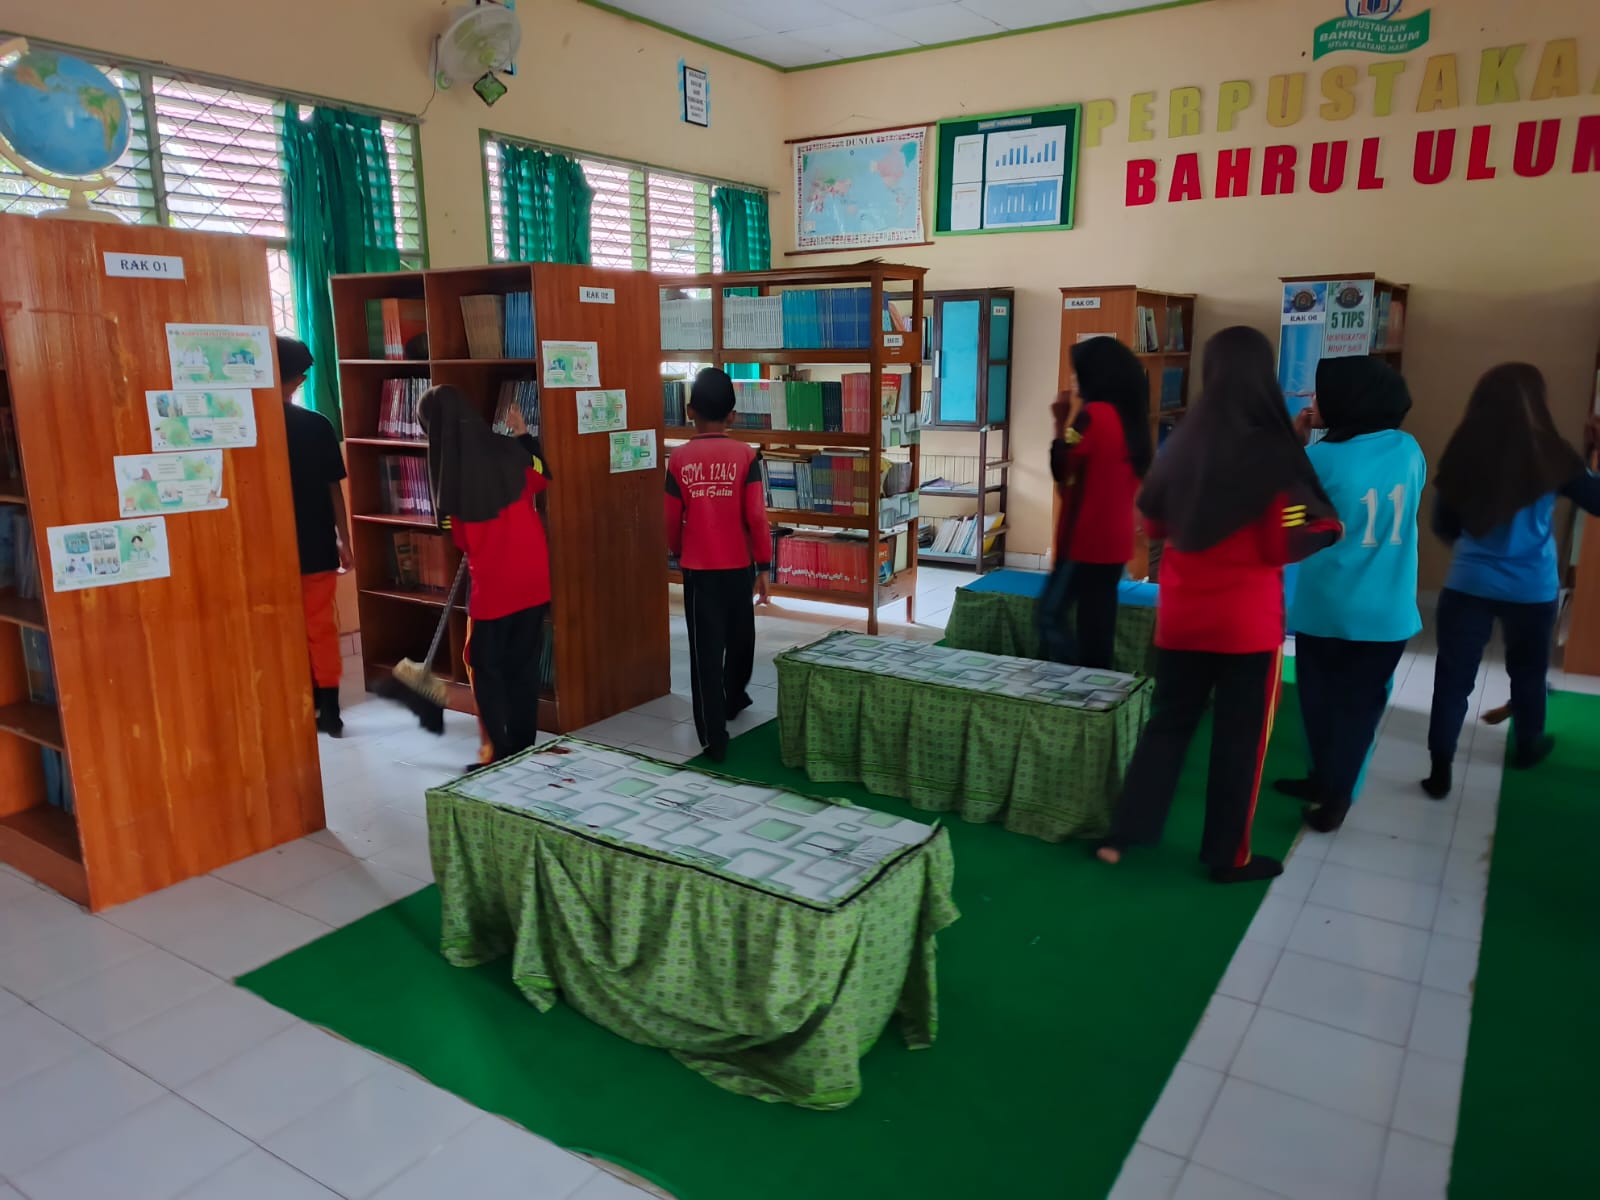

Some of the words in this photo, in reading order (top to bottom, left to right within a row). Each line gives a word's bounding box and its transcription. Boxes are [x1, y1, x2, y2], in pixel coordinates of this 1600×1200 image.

[1335, 19, 1407, 33] PERPUSTAKAAN
[1319, 30, 1374, 42] BAHRUL
[1379, 31, 1420, 43] ULUM
[1085, 37, 1600, 148] PERPUSTAKA
[846, 136, 874, 147] DUNIA
[1125, 137, 1385, 207] BAHRUL
[120, 259, 149, 271] RAK
[152, 261, 168, 272] 01
[1331, 311, 1339, 328] 5
[1340, 311, 1365, 328] TIPS
[1359, 484, 1406, 546] 11
